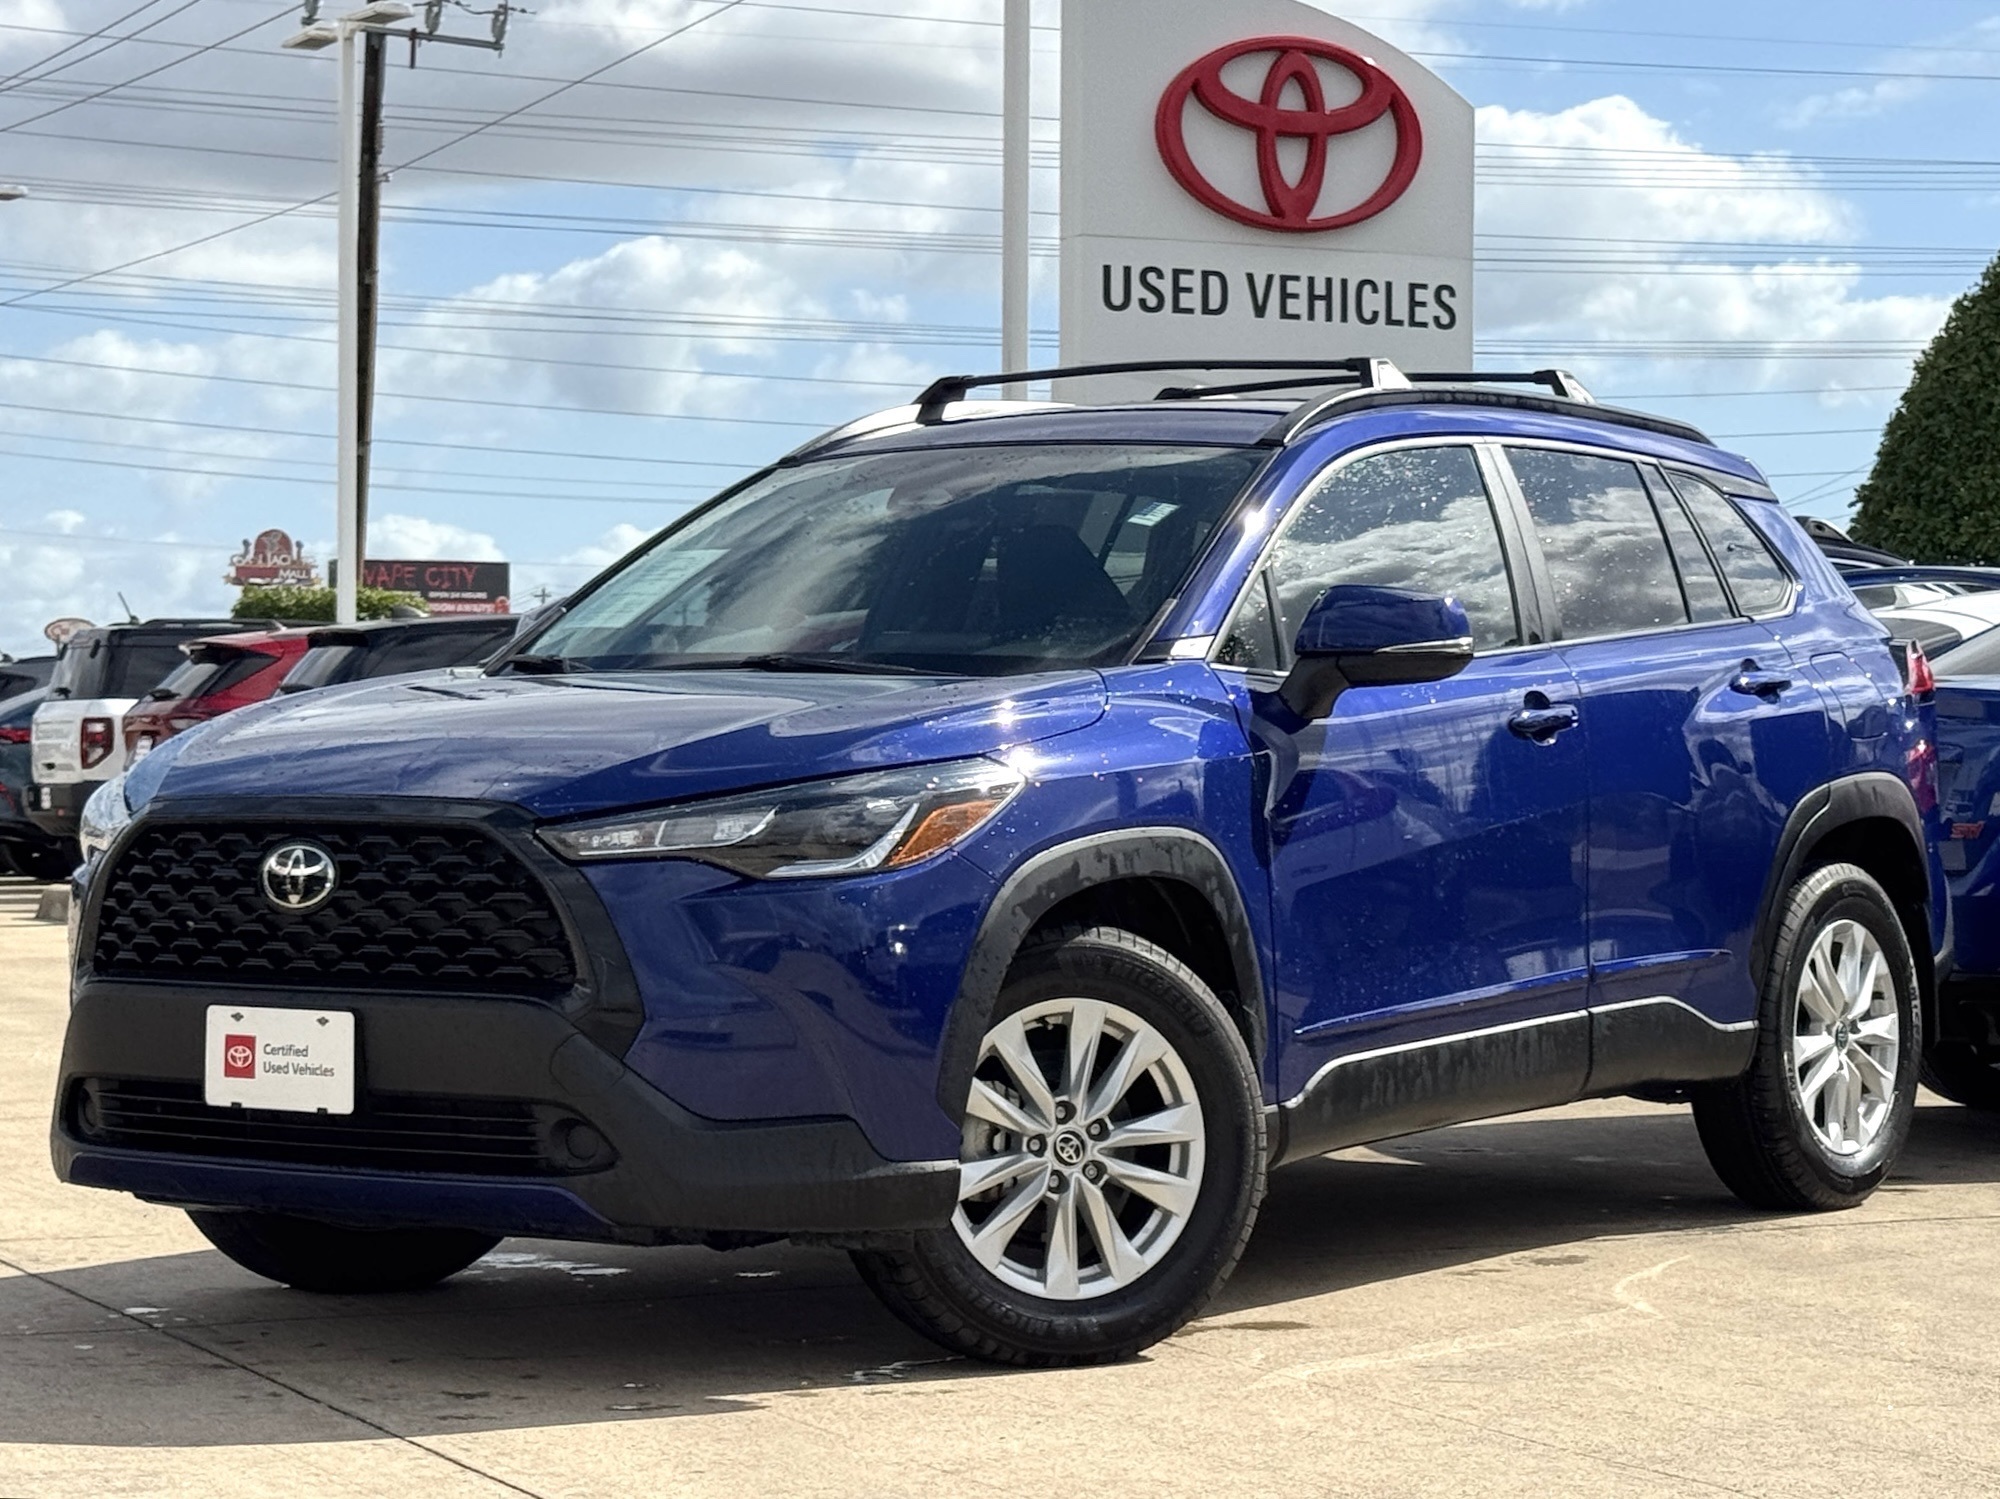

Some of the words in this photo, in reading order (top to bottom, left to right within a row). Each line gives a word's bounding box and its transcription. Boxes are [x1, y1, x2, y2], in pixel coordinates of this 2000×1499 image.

[1101, 263, 1228, 315] USED
[1245, 272, 1457, 330] VEHICLES
[278, 568, 309, 579] MALL
[364, 562, 417, 588] VAPE
[425, 563, 477, 589] CITY
[263, 1043, 309, 1058] Certified
[263, 1061, 290, 1075] Used
[292, 1062, 335, 1077] Vehicles
